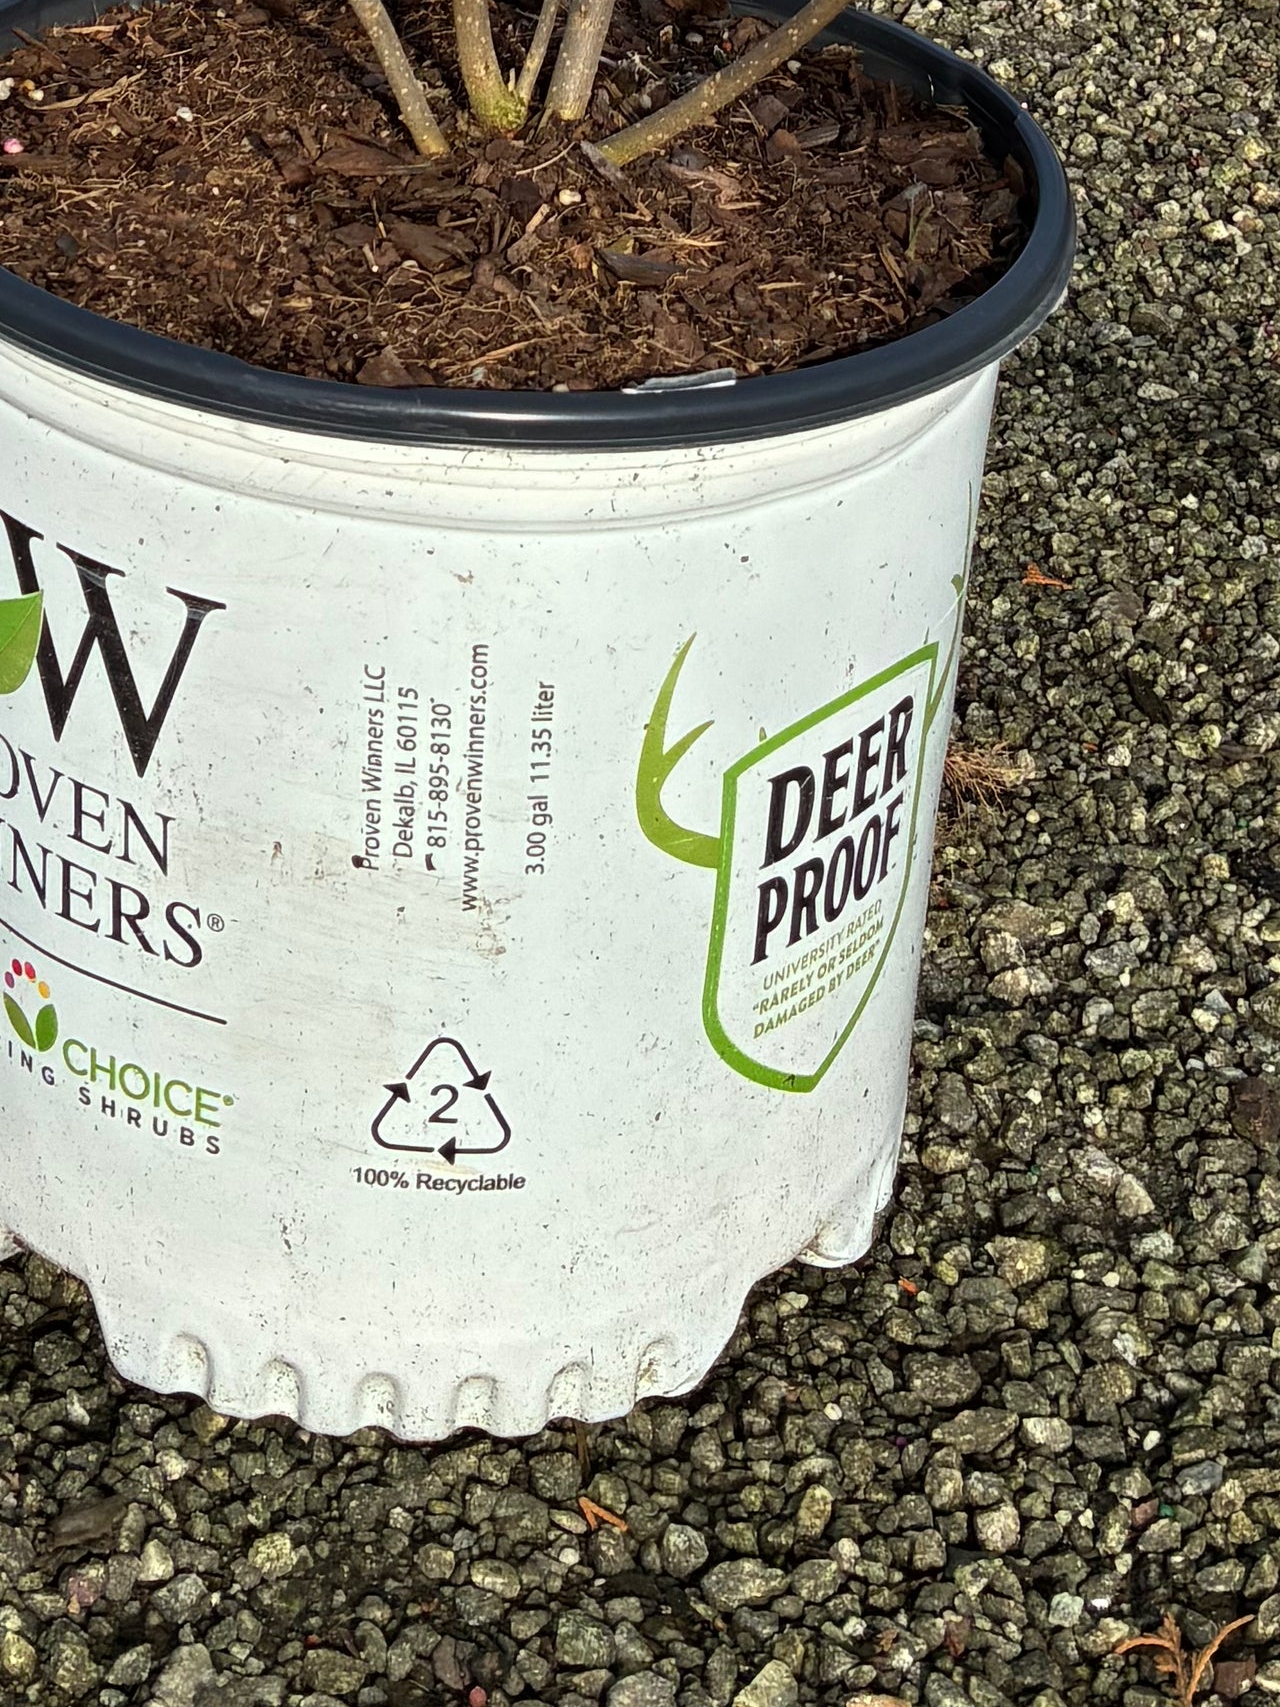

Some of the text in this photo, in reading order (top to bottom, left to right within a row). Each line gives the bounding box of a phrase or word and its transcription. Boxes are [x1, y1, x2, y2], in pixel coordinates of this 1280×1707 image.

[361, 664, 386, 871] Proven Winners LLC
[392, 687, 419, 859] Dekalb, IL 60115
[427, 702, 452, 849] 815-895-8130
[461, 643, 489, 912] www.provenwinners.com
[525, 681, 555, 875] 3.00 gal 11.35 liter
[759, 695, 914, 871] DEER
[750, 790, 904, 966] PROOF
[763, 898, 882, 991] UNIVERSITY RATED
[817, 956, 837, 980] OR
[838, 915, 884, 965] SELDOM
[753, 984, 826, 1039] DAMAGED
[828, 969, 844, 994] BY
[78, 1085, 221, 1155] SHRUBS
[428, 1083, 459, 1124] 2
[352, 1167, 527, 1196] 100% Recyclable
